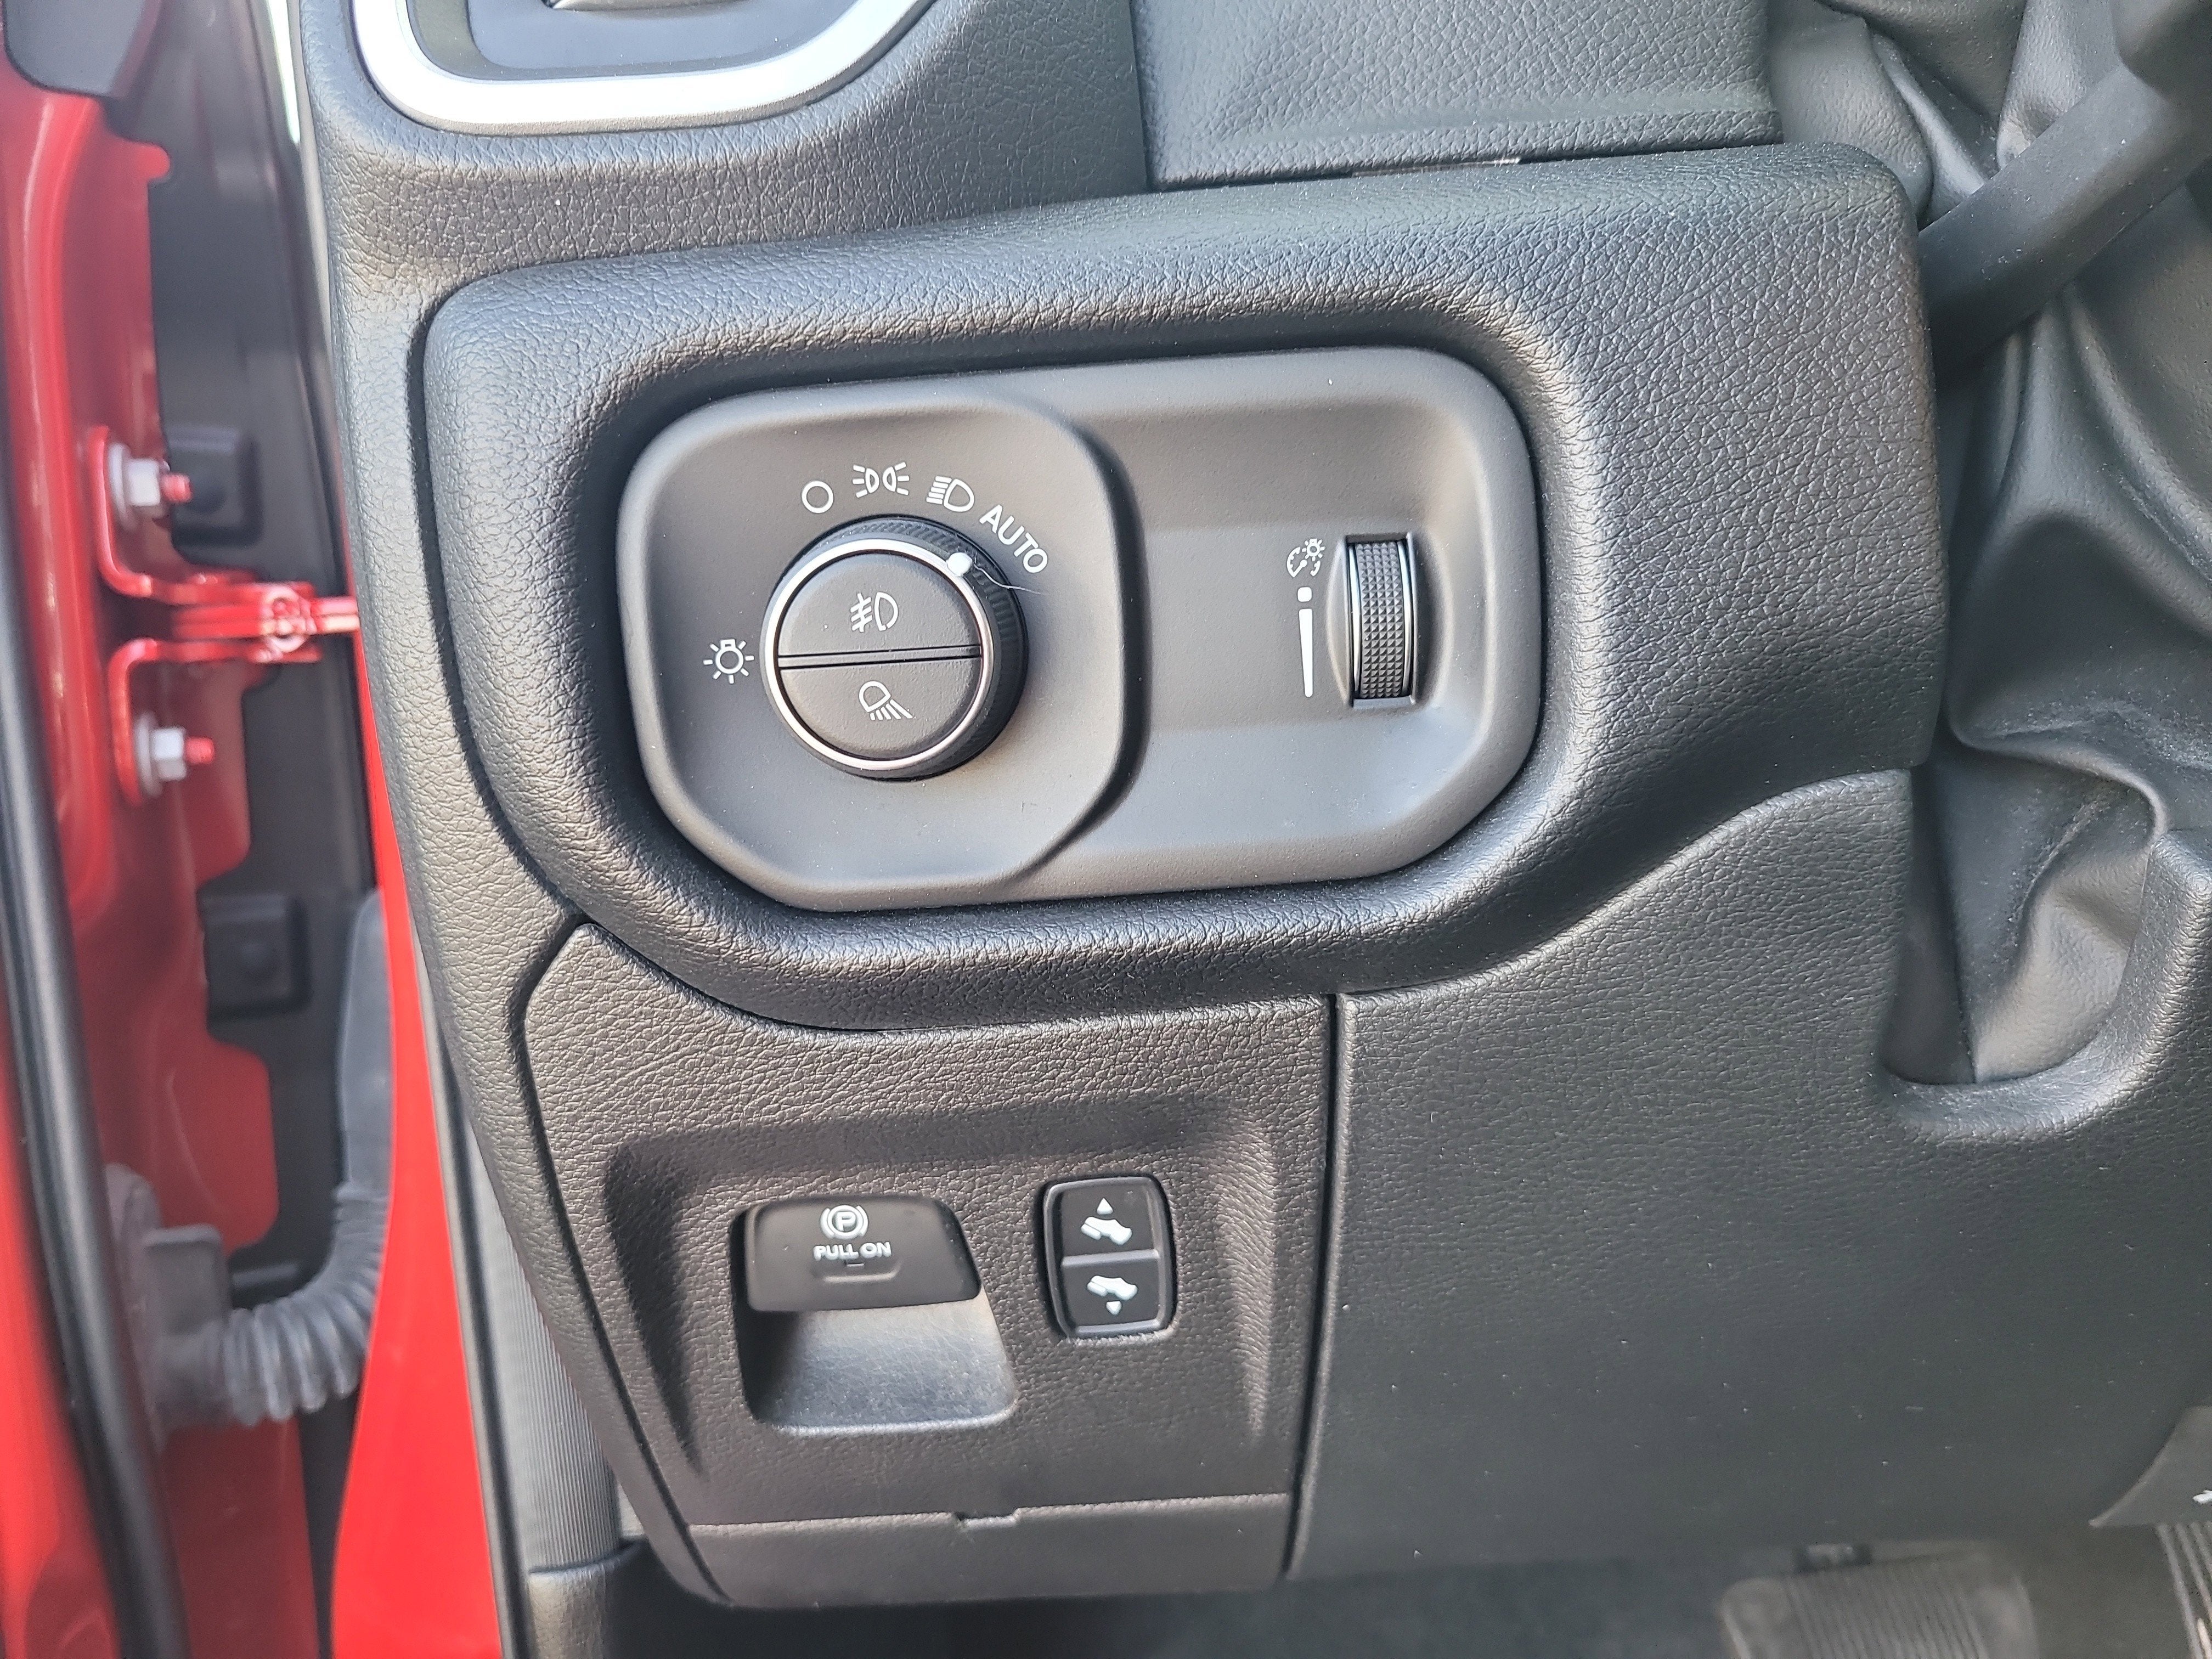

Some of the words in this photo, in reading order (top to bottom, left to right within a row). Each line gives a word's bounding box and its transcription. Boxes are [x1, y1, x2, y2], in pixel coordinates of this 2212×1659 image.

[979, 504, 1048, 573] AUTO
[813, 1244, 859, 1261] PULL
[859, 1242, 892, 1259] ON
